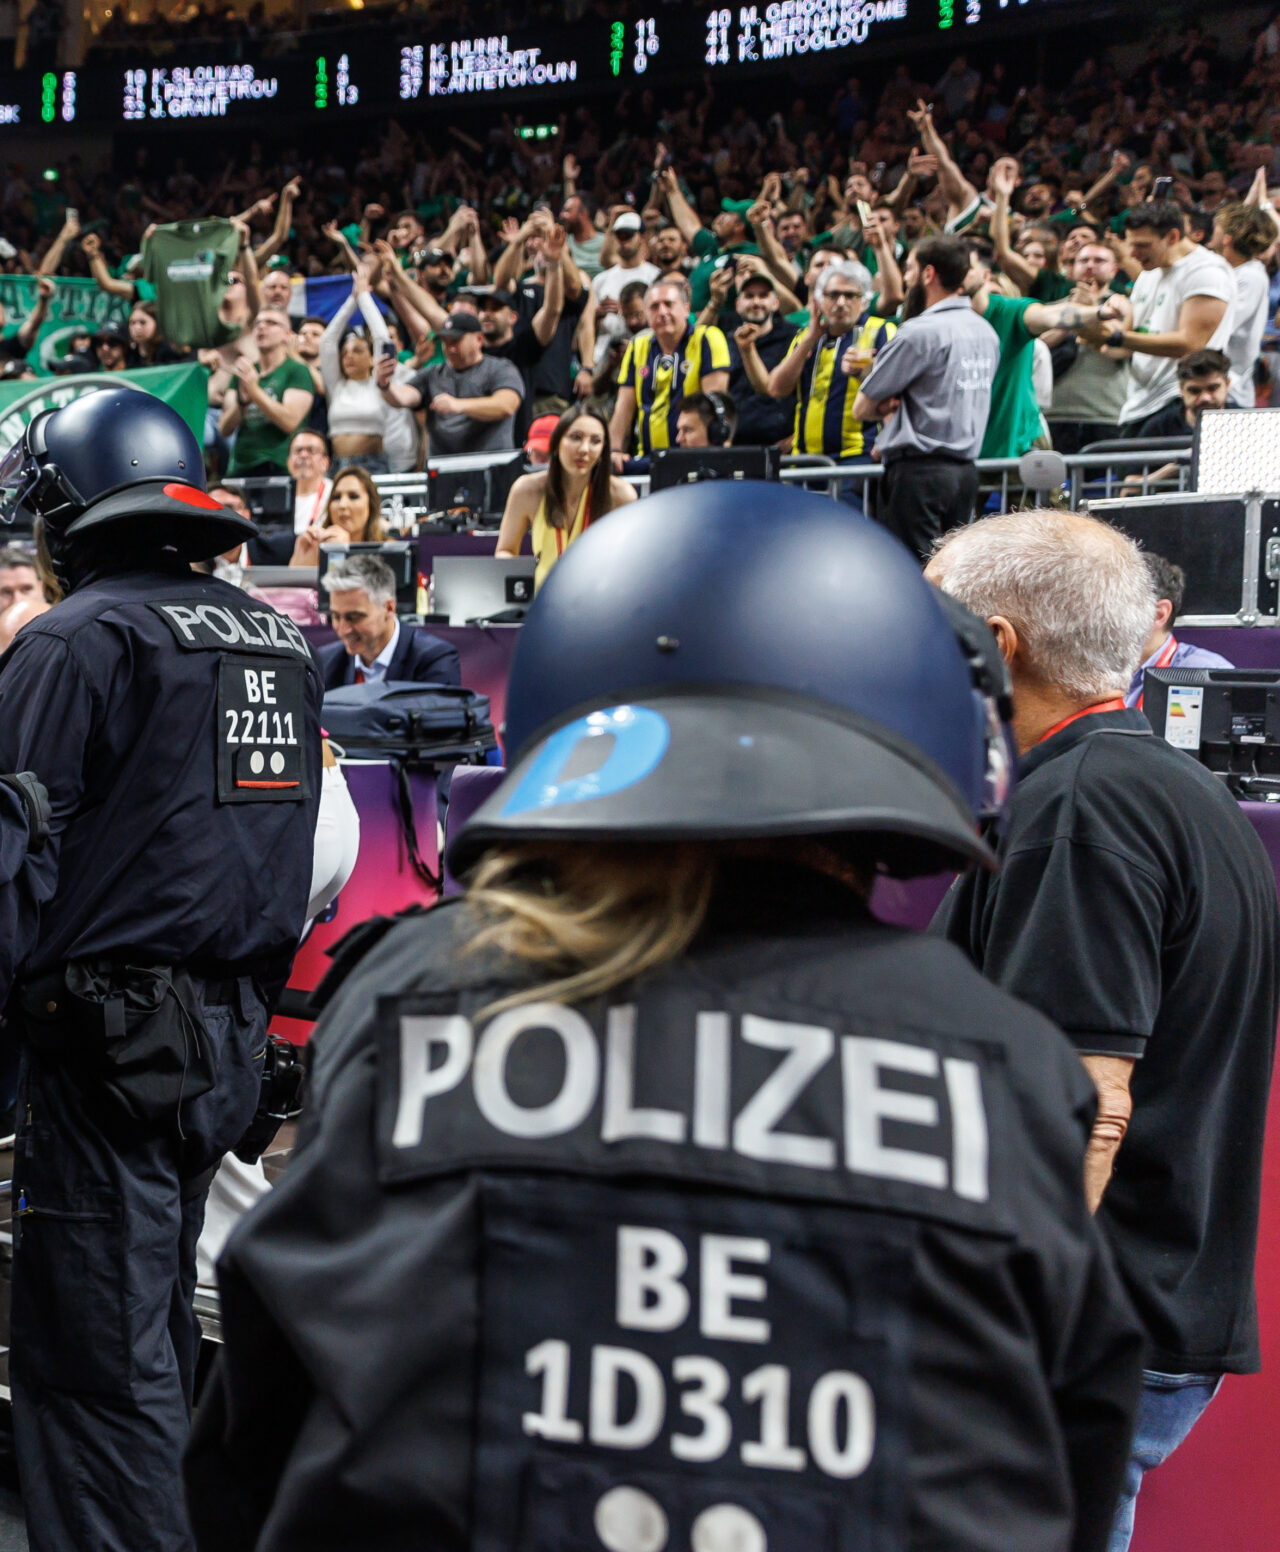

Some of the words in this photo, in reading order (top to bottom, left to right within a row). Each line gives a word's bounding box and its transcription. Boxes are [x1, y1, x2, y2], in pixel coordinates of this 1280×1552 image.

[762, 22, 869, 59] MITOGLOU
[160, 604, 312, 659] POLIZEI
[244, 669, 277, 705] BE
[225, 709, 298, 745] 22111
[392, 1000, 989, 1203] POLIZEI
[616, 1224, 772, 1344] BE
[522, 1338, 877, 1481] 1D310
